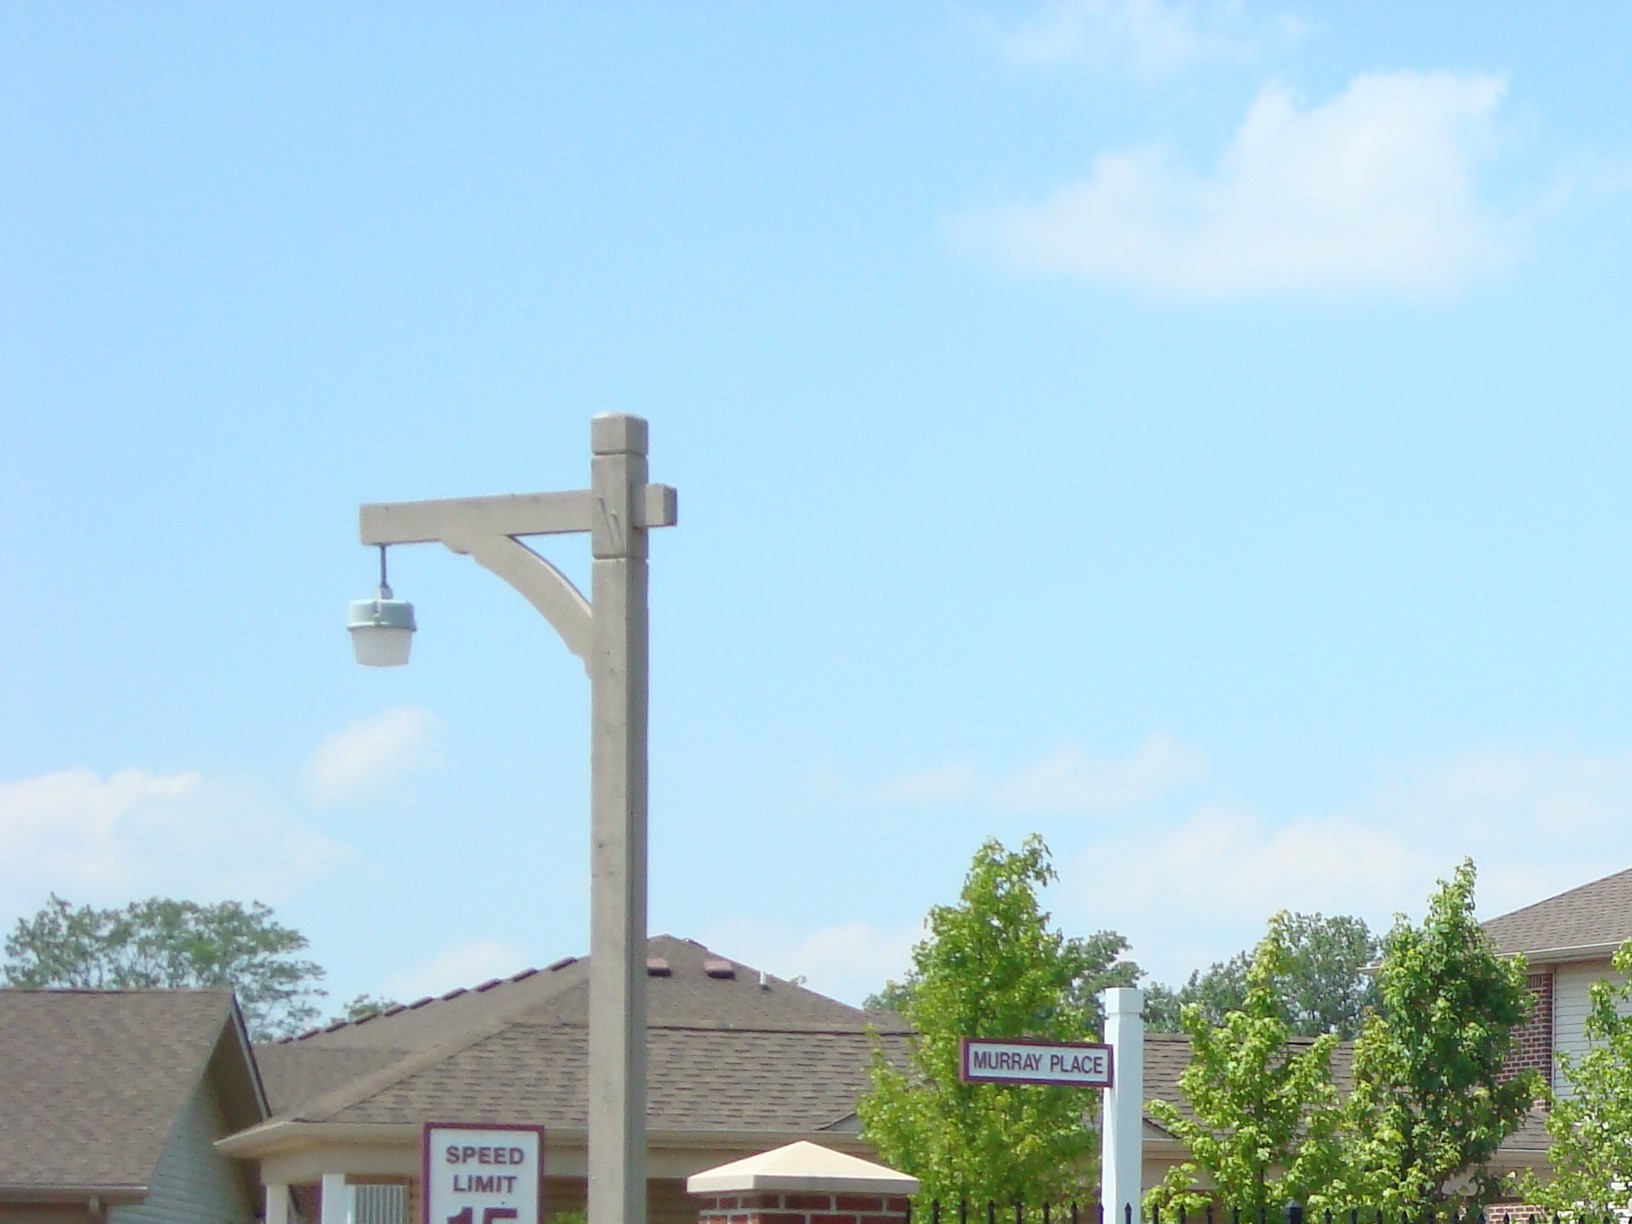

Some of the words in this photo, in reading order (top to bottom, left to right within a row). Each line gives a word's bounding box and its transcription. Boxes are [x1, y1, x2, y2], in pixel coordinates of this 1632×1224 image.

[973, 1051, 1042, 1071] MURRAY
[1050, 1054, 1103, 1074] PLACE
[446, 1145, 524, 1165] SPEED
[453, 1174, 517, 1194] LIMIT
